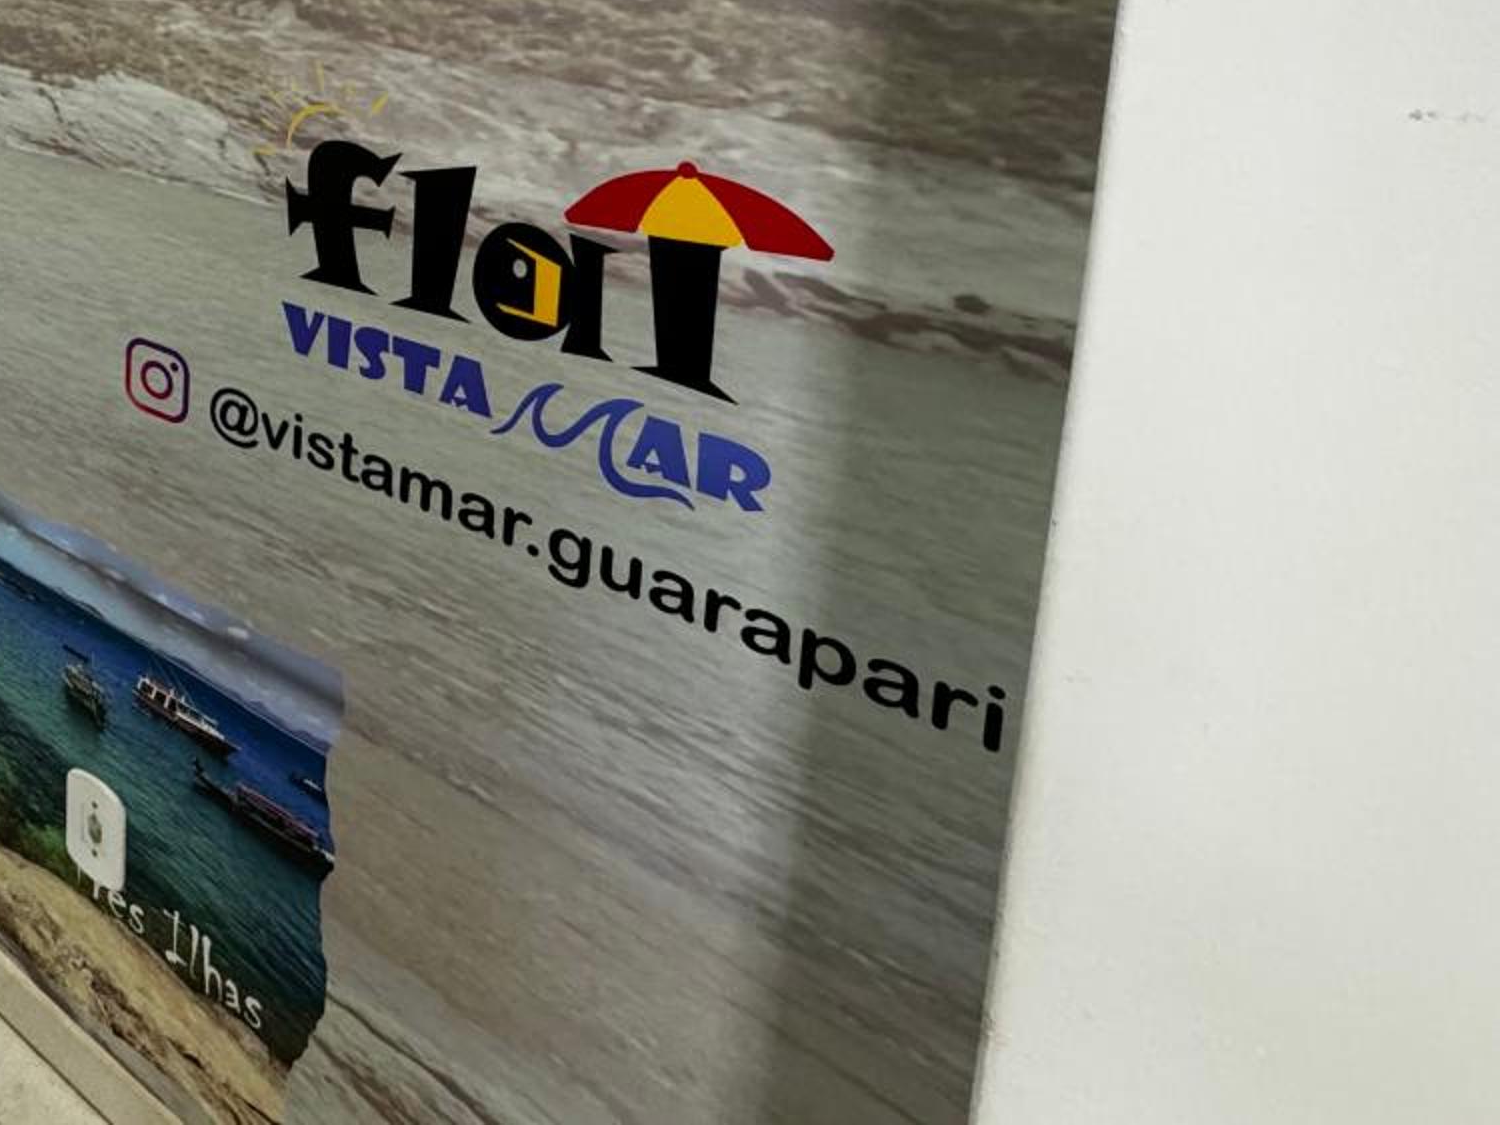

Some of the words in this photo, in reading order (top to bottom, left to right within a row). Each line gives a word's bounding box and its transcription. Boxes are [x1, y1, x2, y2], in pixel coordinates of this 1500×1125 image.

[282, 301, 493, 420] VISTA
[285, 139, 740, 406] flat
[208, 386, 1008, 756] @vistamar.guarapari
[163, 908, 263, 1030] Ilhas
